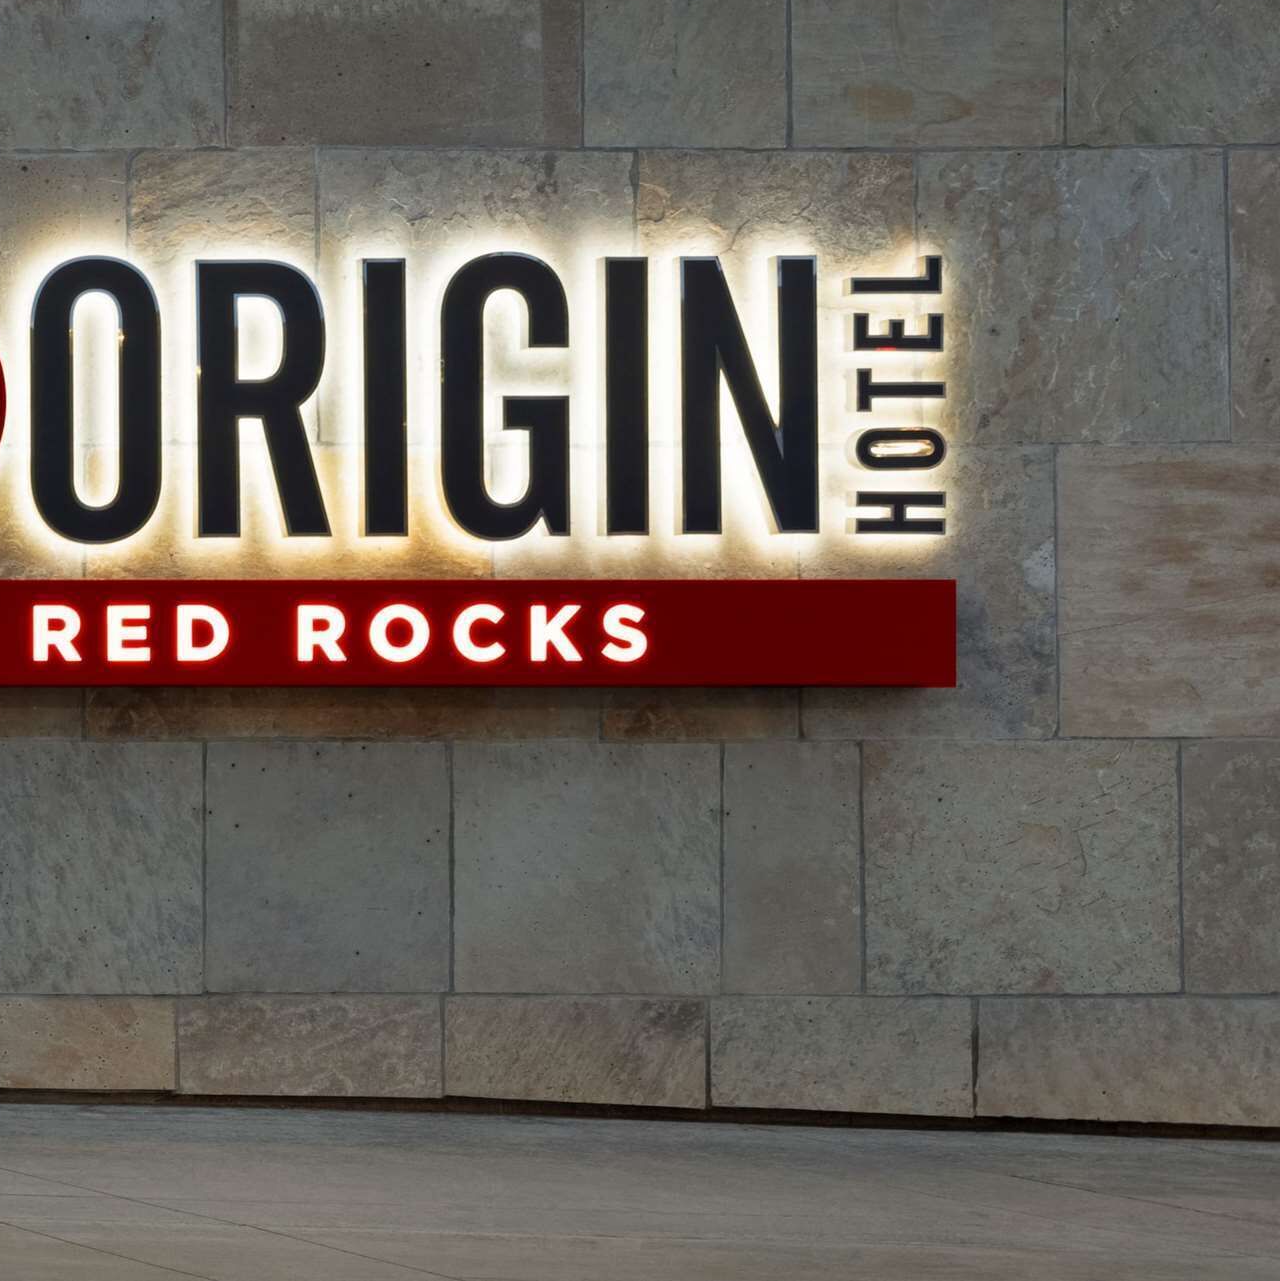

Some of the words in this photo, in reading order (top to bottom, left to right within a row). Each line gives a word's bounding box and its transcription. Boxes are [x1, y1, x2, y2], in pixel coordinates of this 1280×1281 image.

[30, 254, 820, 544] ORIGIN
[848, 254, 947, 536] HOTEL
[32, 604, 230, 662] RED
[297, 603, 648, 663] ROCKS
